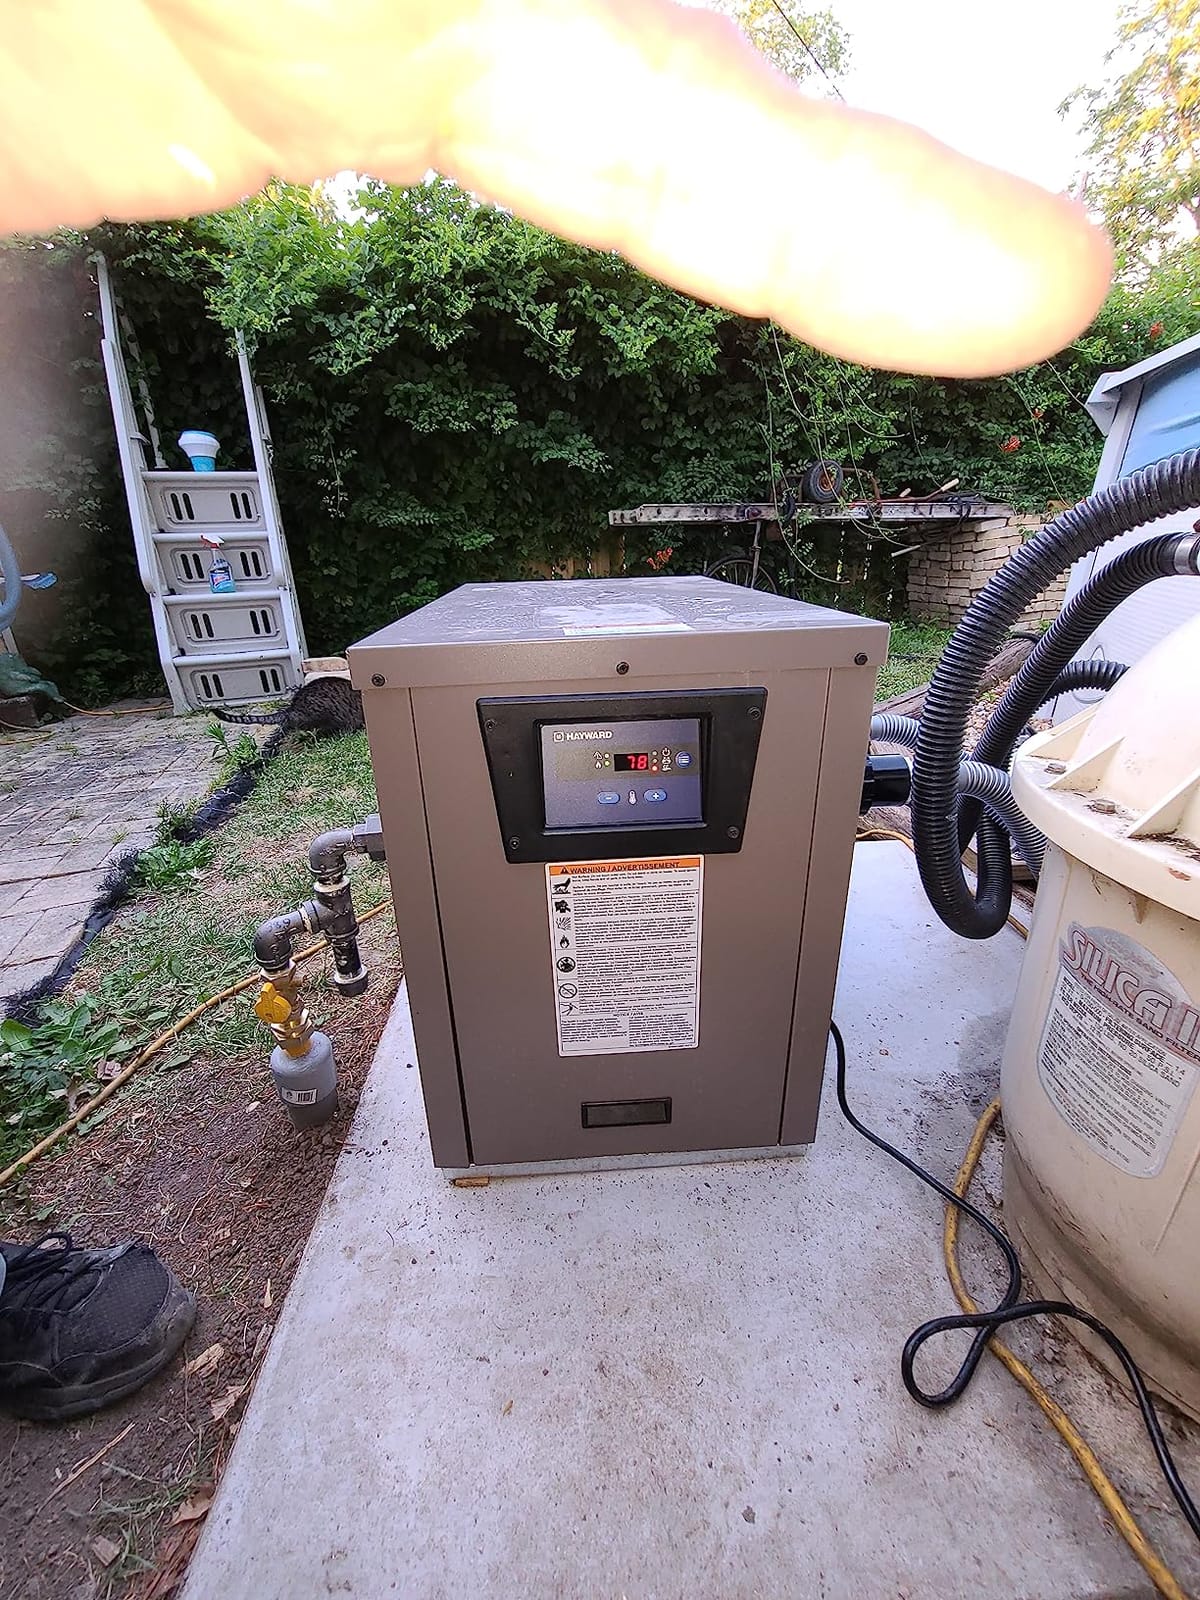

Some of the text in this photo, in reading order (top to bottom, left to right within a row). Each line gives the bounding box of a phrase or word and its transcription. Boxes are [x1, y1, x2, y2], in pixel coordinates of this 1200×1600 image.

[566, 730, 613, 741] HAYWARD
[627, 755, 648, 769] 78
[570, 866, 606, 875] WARNING
[612, 861, 680, 872] ADVERTISSEMENT
[1063, 930, 1172, 1030] SILICA
[1081, 971, 1093, 986] THE
[1136, 1018, 1163, 1038] SAND
